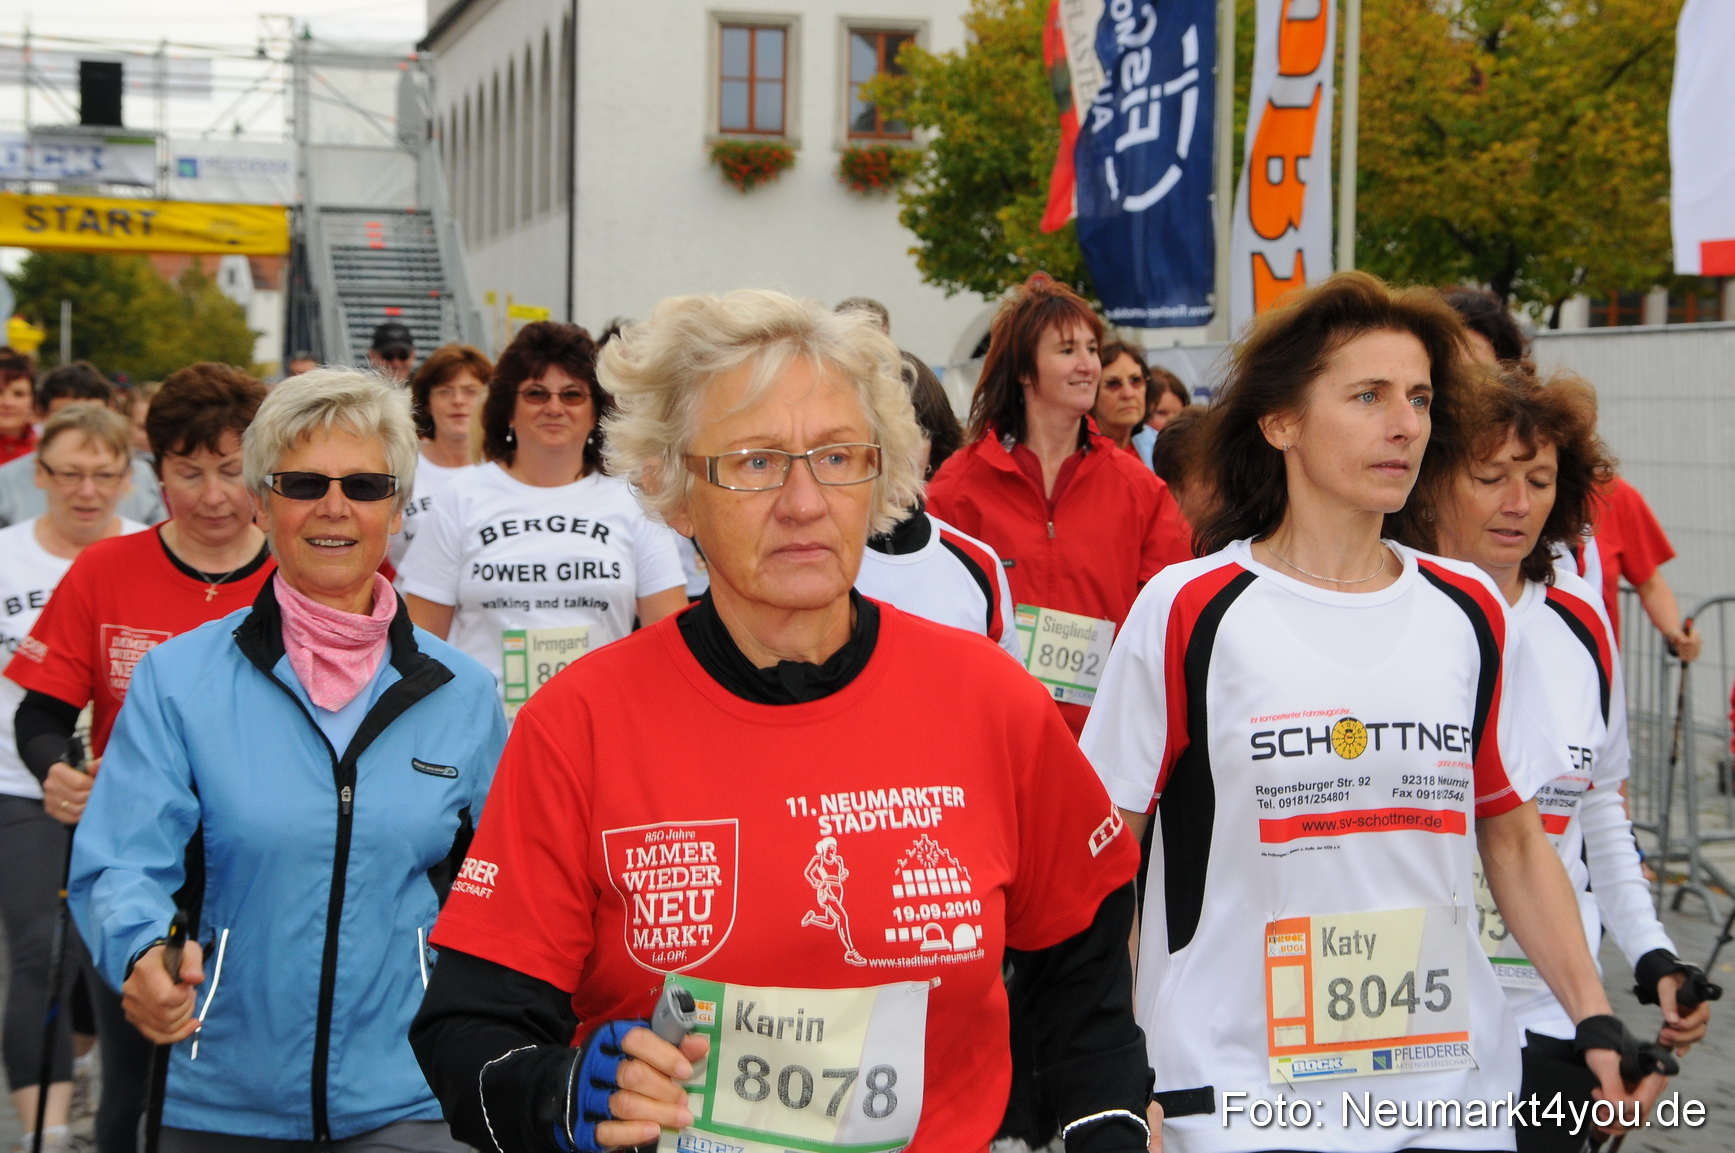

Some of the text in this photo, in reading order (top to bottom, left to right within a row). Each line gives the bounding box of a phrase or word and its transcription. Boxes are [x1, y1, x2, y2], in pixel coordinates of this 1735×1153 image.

[24, 205, 158, 237] START
[479, 515, 610, 547] BERGER
[472, 562, 621, 583] POWER GIRLS
[482, 597, 609, 612] walking and talking
[1042, 615, 1099, 641] Sieglinde
[533, 631, 589, 654] Irmgard
[1038, 643, 1100, 676] 8092
[1255, 776, 1371, 797] Regensburger Str. 92
[1392, 788, 1413, 798] Fax
[1402, 775, 1435, 786] 92318
[786, 786, 966, 818] 11. NEUMARKTER
[1257, 791, 1350, 809] Tel. 09181/254801
[818, 807, 943, 836] STADTLAUF
[1302, 812, 1442, 832] www.sv-schottner.de
[645, 828, 696, 843] 850 Jahre
[625, 841, 717, 870] IMMER
[622, 864, 722, 892] WIEDER
[632, 889, 715, 925] NEU
[893, 899, 981, 923] 19.09.2010
[633, 924, 713, 949] MARKT
[1321, 926, 1377, 960] Katy
[869, 947, 985, 969] www.stadtlauf-neumarkt.de
[1327, 968, 1452, 1022] 8045
[734, 999, 825, 1043] Karin
[1292, 1043, 1469, 1073] BOCK PFLEIDERER
[734, 1054, 898, 1119] 8078
